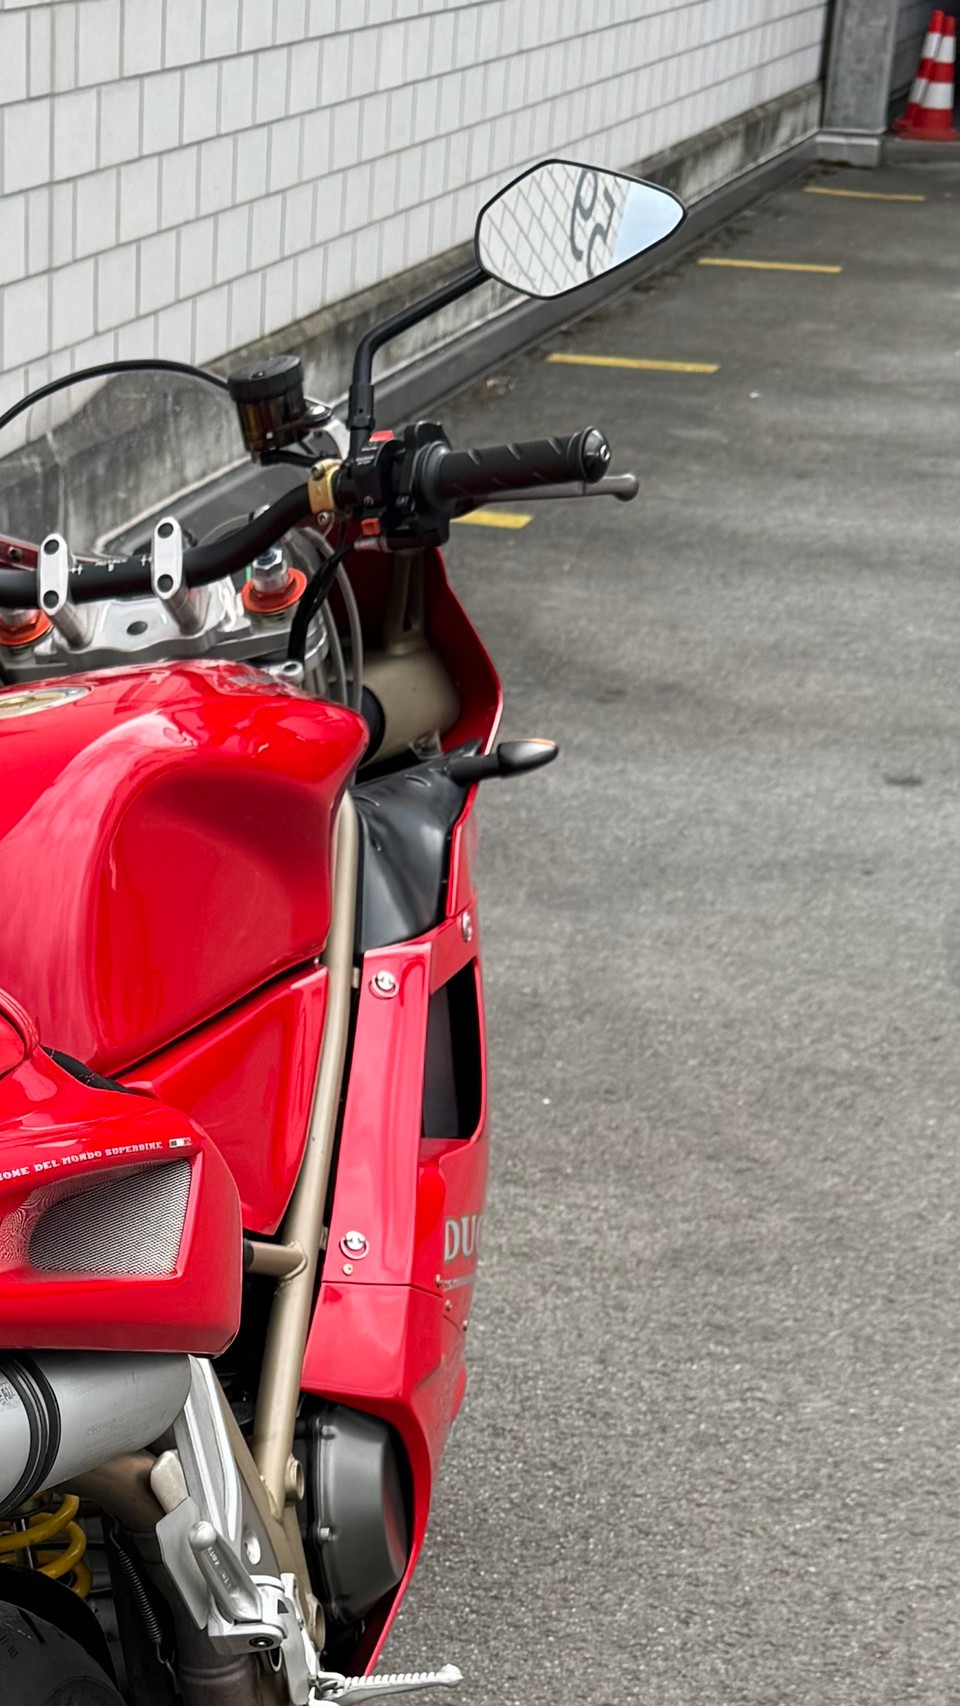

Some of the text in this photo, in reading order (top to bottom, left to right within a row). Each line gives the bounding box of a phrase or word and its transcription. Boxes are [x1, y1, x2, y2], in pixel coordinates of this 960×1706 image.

[34, 1160, 60, 1172] DEL
[62, 1151, 102, 1165] MONDO
[105, 1141, 163, 1157] SUPERBIKE
